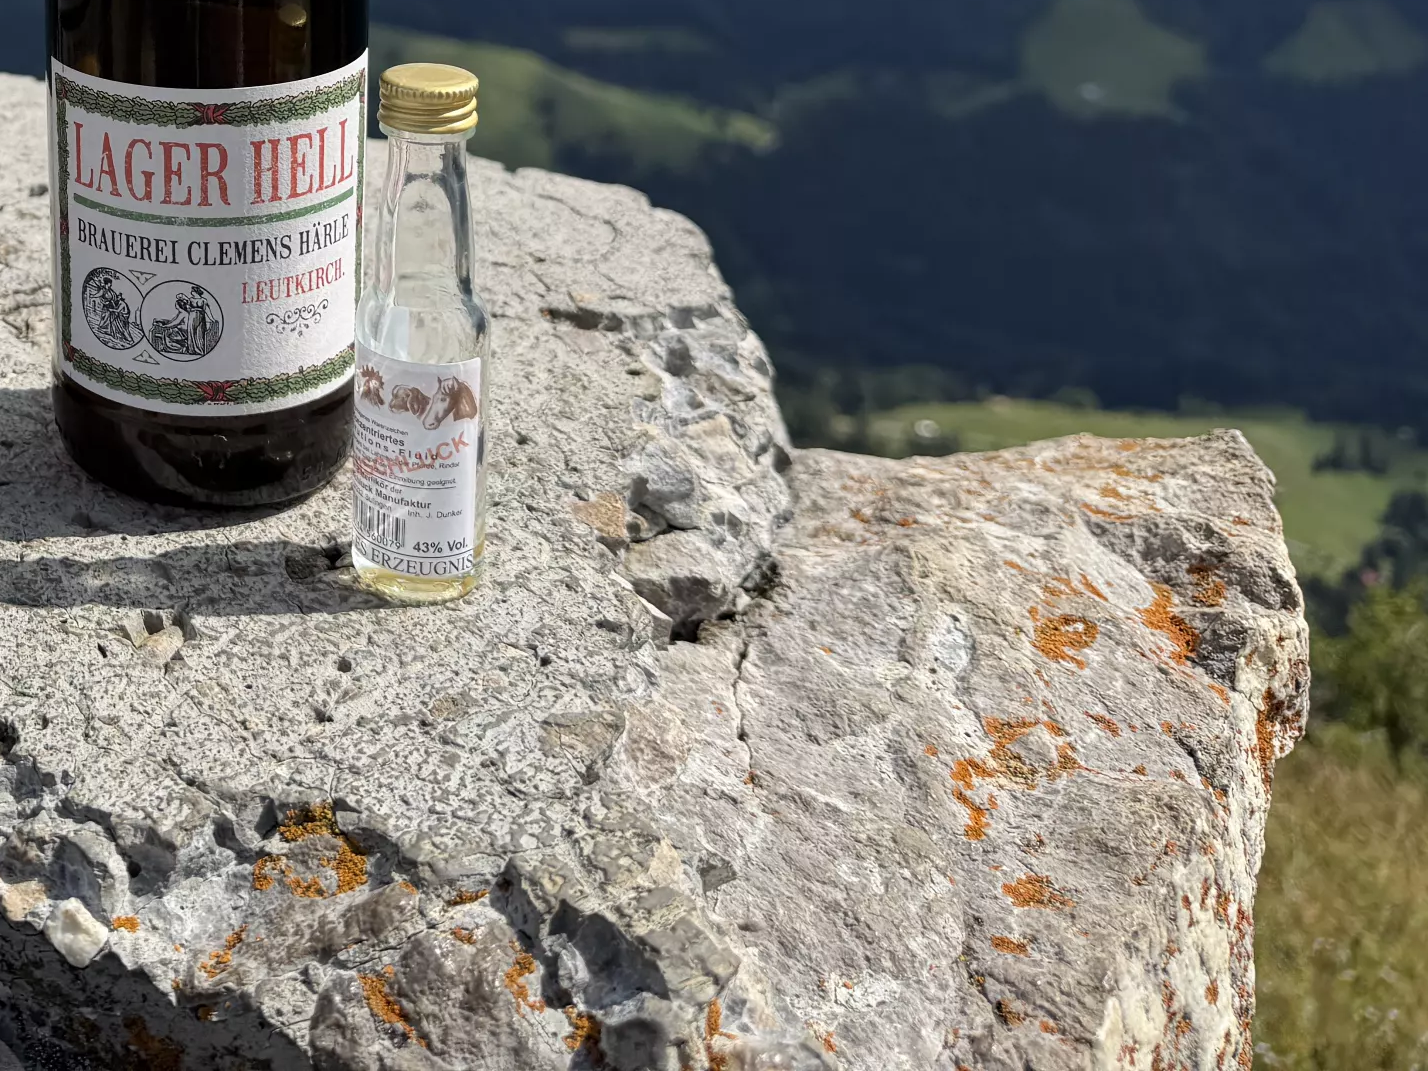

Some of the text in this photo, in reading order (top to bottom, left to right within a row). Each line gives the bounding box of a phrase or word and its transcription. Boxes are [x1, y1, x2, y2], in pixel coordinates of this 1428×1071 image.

[74, 118, 354, 207] LAGER HELL
[77, 213, 349, 266] BRAUEREI CLEMENS HÄRLE
[241, 258, 345, 305] LEUTKIRCH.
[375, 488, 432, 510] Manufaktur
[436, 509, 463, 519] Dunker
[412, 537, 468, 554] 43% Vol.
[371, 547, 473, 576] ERZEUGNIS
